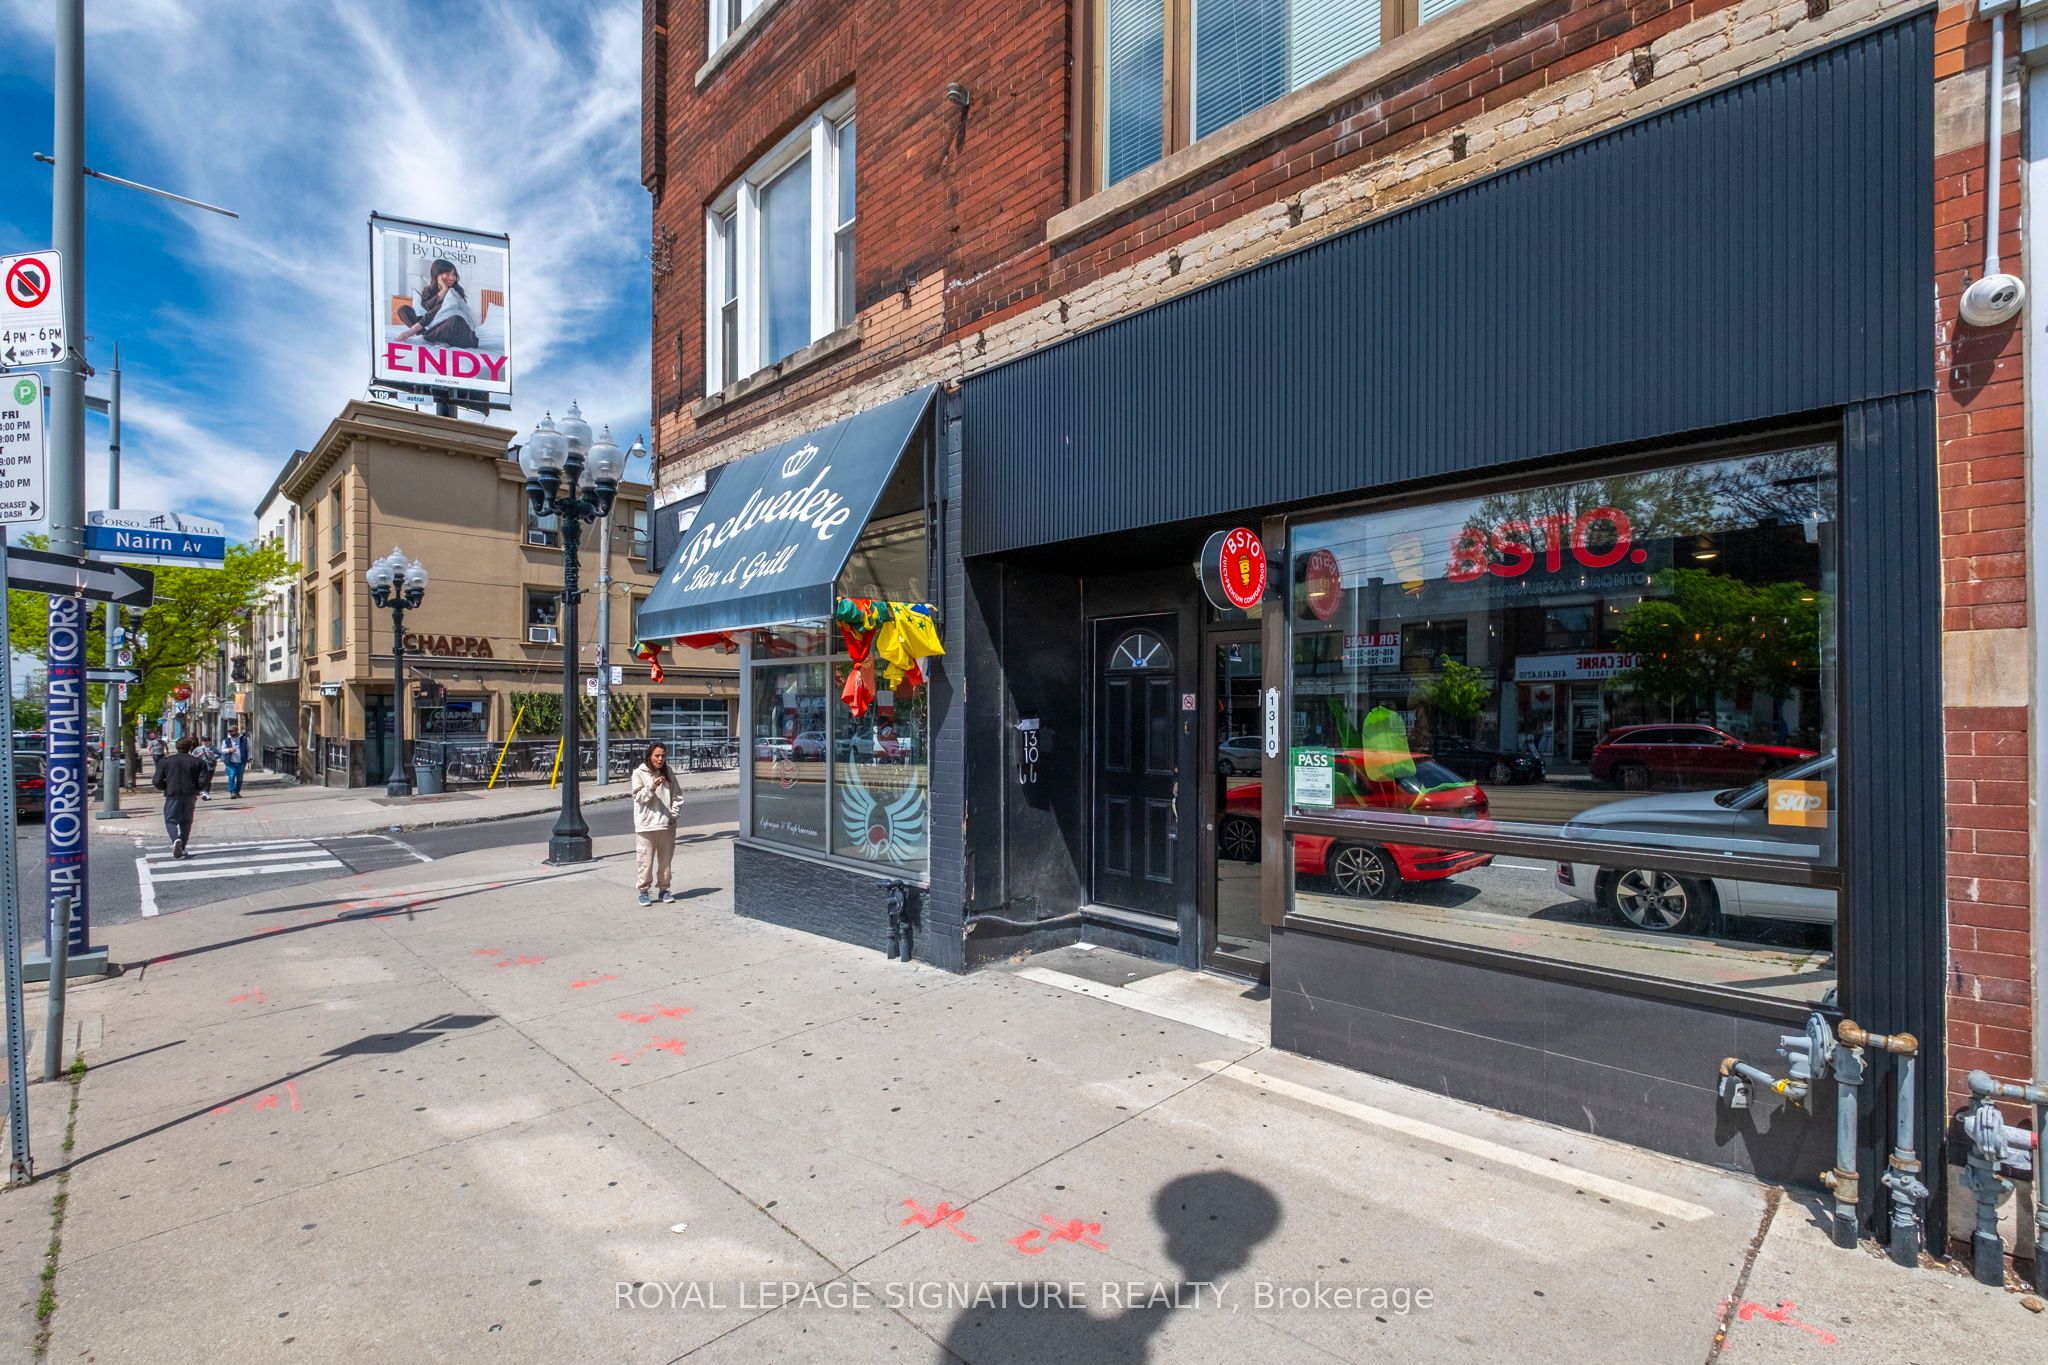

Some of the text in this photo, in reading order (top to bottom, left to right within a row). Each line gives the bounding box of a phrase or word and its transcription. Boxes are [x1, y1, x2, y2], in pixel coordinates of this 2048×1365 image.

[419, 231, 471, 252] Dreamy
[412, 243, 477, 264] By Design
[3, 330, 10, 344] 4
[13, 332, 27, 343] PM
[39, 327, 47, 341] 6
[48, 328, 62, 340] PM
[20, 348, 48, 358] MON-FRI
[381, 342, 508, 381] ENDY
[373, 390, 389, 400] 109
[406, 395, 425, 403] astral
[2, 410, 19, 420] FRI
[17, 420, 31, 430] PM
[17, 433, 30, 442] PM
[18, 455, 32, 465] PM
[17, 478, 31, 488] PM
[4, 510, 23, 519] DASH
[672, 465, 851, 584] Belvedere
[116, 531, 202, 552] Nairn Av
[1227, 531, 1260, 557] BSTO
[684, 564, 720, 593] Bar
[739, 544, 800, 590] Grill
[1571, 571, 1648, 591] TORONTO
[50, 594, 79, 662] CORS
[403, 633, 494, 658] CHAPPA
[49, 677, 80, 759] ITALIA
[433, 710, 475, 720] CHAPPA
[1268, 696, 1276, 751] 1310
[1024, 730, 1038, 748] 13
[1023, 746, 1039, 764] 10
[1298, 754, 1329, 767] PASS
[50, 765, 81, 848] CORSO
